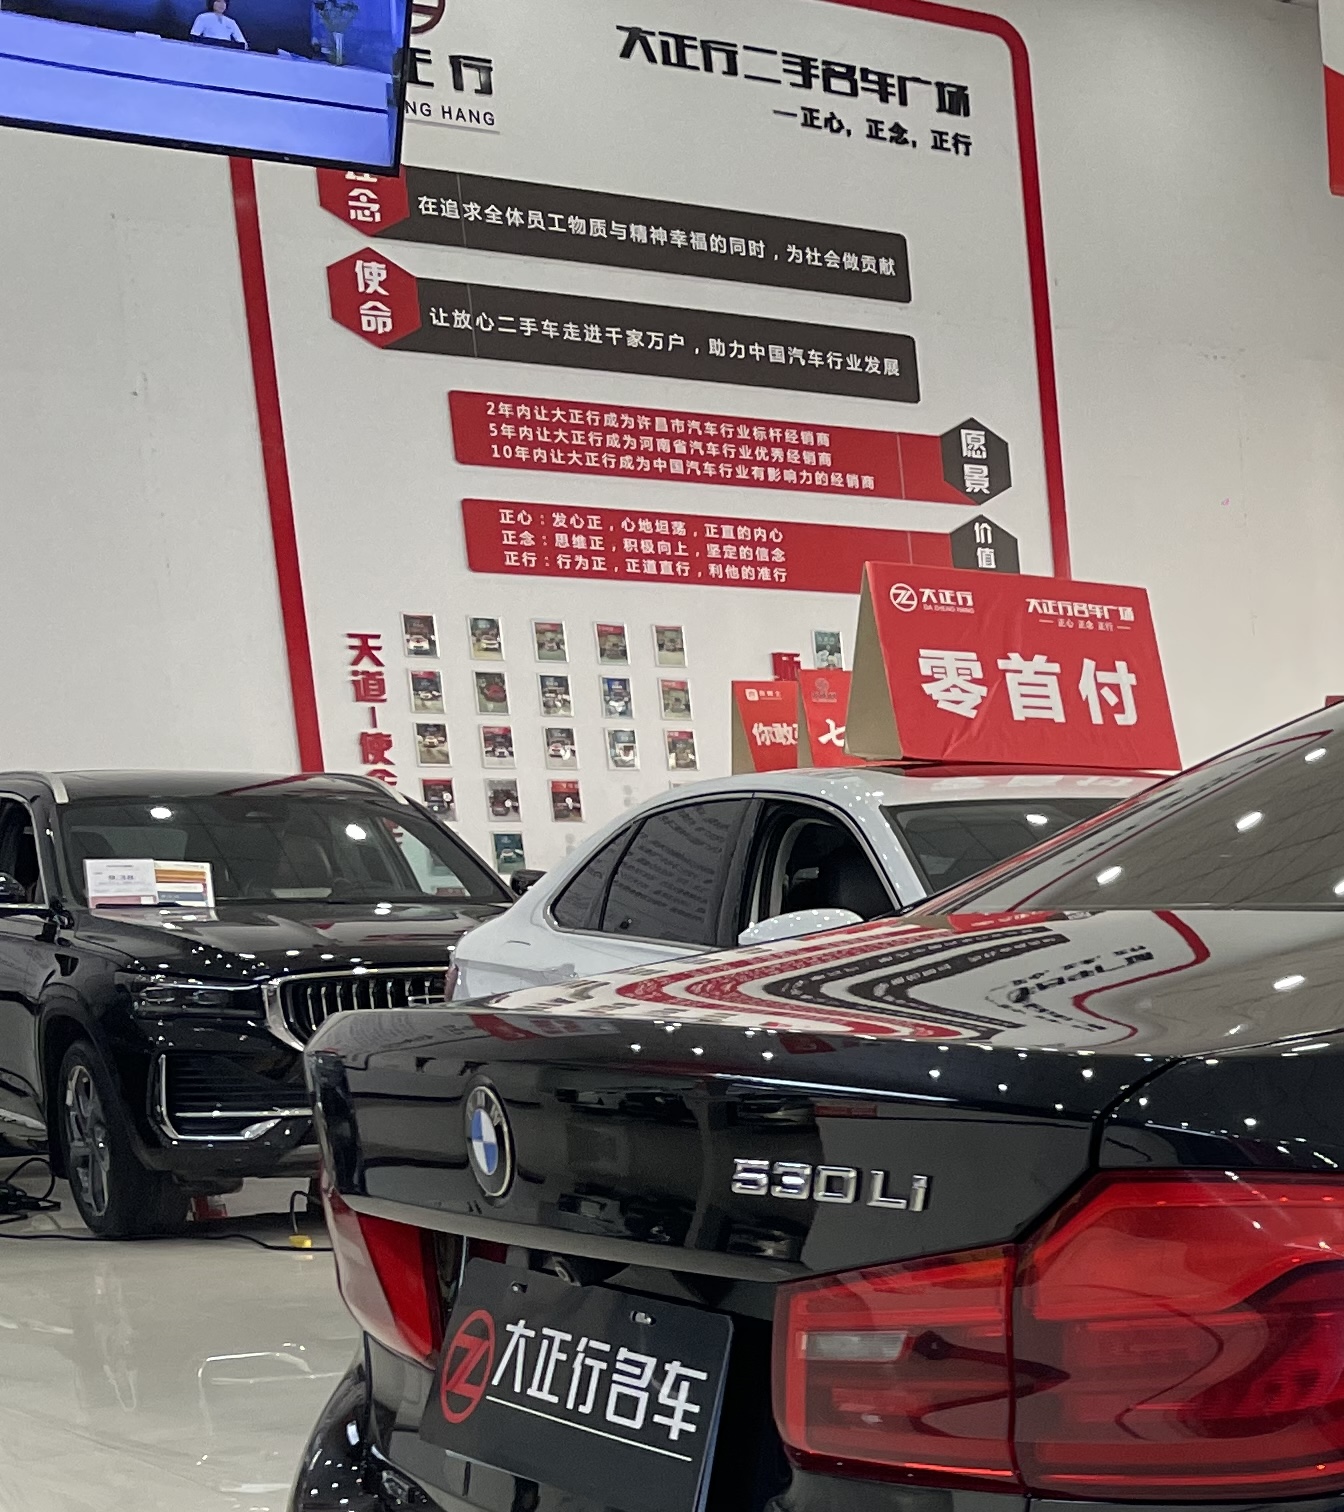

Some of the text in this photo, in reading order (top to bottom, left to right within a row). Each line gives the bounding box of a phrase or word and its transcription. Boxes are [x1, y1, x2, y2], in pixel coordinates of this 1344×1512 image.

[616, 25, 971, 117] 大正行二手名车广场
[441, 105, 496, 126] HANG
[345, 170, 381, 222] 念
[354, 259, 393, 334] 使命
[960, 428, 990, 494] 愿景
[919, 588, 973, 606] 大正行
[1025, 598, 1134, 621] 大正行名车广场
[918, 648, 1137, 726] 零首付
[492, 1319, 707, 1440] 大正行名车
